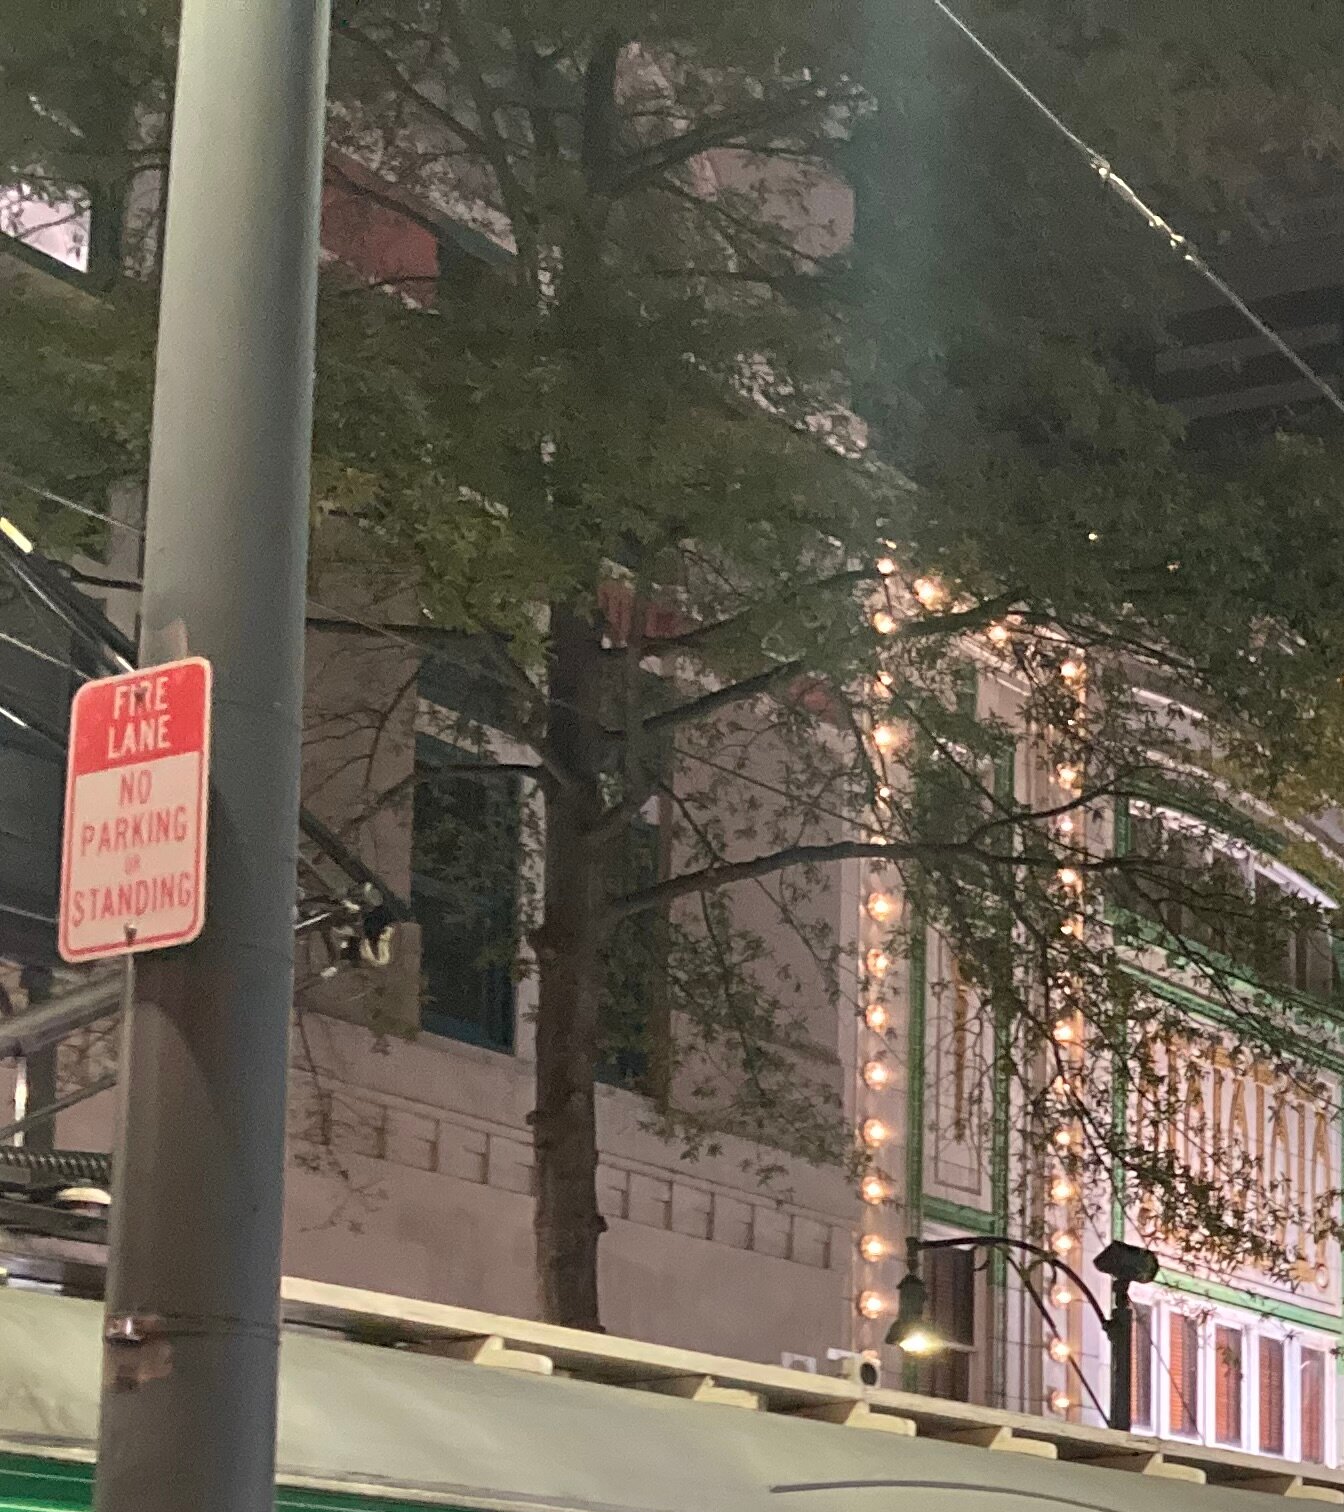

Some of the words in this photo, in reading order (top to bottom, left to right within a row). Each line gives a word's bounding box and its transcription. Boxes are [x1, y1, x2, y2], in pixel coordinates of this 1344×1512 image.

[113, 677, 169, 720] FIRE
[107, 714, 172, 759] LANE
[120, 769, 152, 807] NO
[80, 805, 188, 856] PARKING
[72, 872, 192, 927] STANDING
